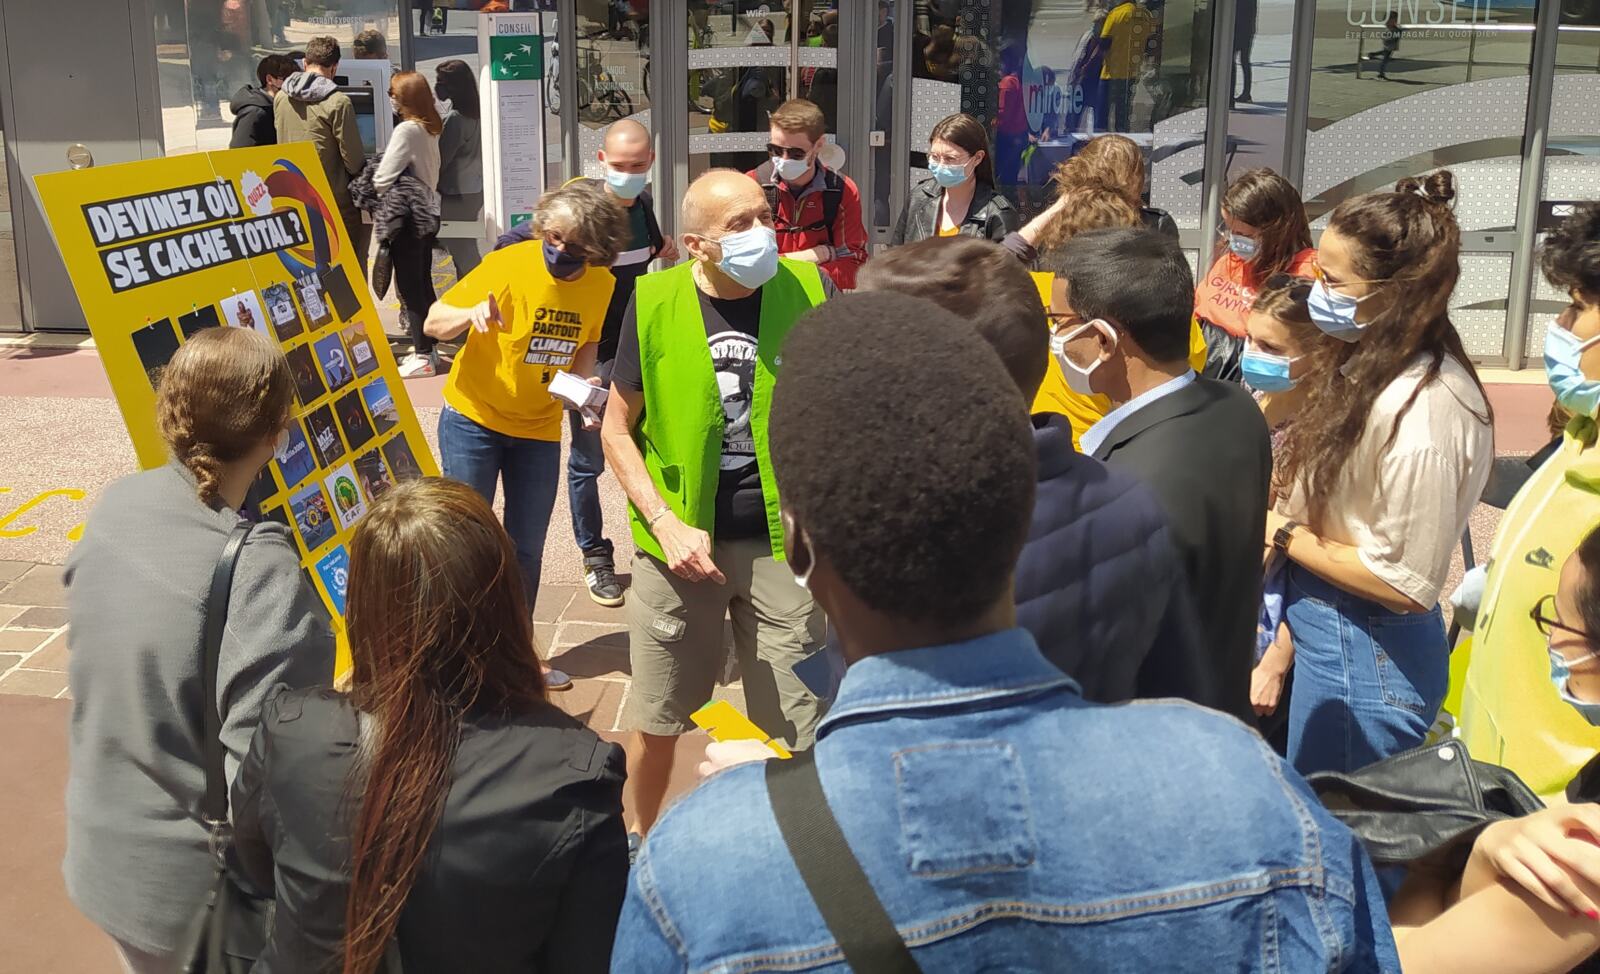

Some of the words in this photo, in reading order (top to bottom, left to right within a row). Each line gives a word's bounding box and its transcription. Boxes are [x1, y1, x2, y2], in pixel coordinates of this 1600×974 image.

[746, 9, 766, 17] WiFi
[498, 23, 531, 34] CONSEIL
[1345, 30, 1367, 39] ÊTRE
[1369, 30, 1430, 39] ACCOMPAGNÉ
[247, 182, 267, 208] QUIZZ
[88, 188, 207, 243] DEVINEZ
[203, 183, 240, 217] OÙ
[106, 247, 150, 288] SE
[148, 228, 233, 277] CACHE
[229, 216, 294, 257] TOTAL
[288, 212, 304, 242] ?
[548, 308, 582, 325] TOTAL
[532, 321, 581, 338] PARTOUT
[530, 337, 577, 354] CLIMAT
[525, 352, 548, 364] NULLE
[549, 355, 573, 366] PART
[345, 506, 362, 522] CAF
